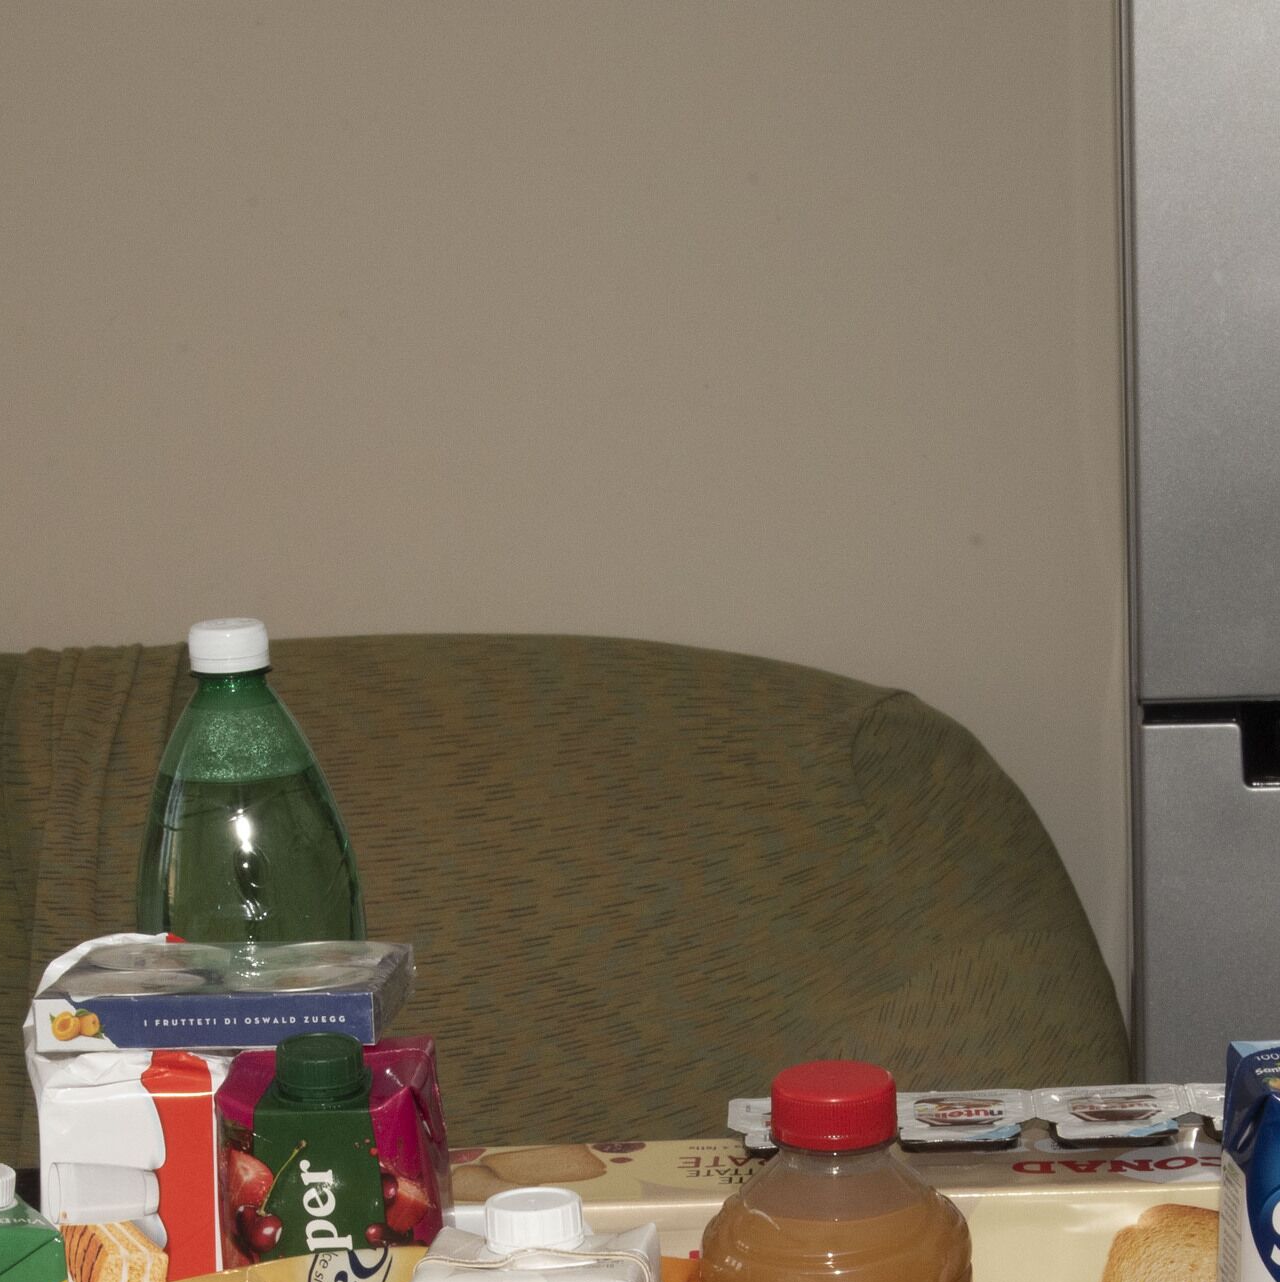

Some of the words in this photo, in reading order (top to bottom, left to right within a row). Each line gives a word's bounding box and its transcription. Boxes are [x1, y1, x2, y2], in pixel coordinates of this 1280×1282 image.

[143, 1018, 149, 1028] I
[154, 1017, 218, 1028] FRUTTETI
[223, 1016, 238, 1026] DI
[243, 1015, 298, 1026] OSWALD
[302, 1013, 347, 1025] ZUEGG
